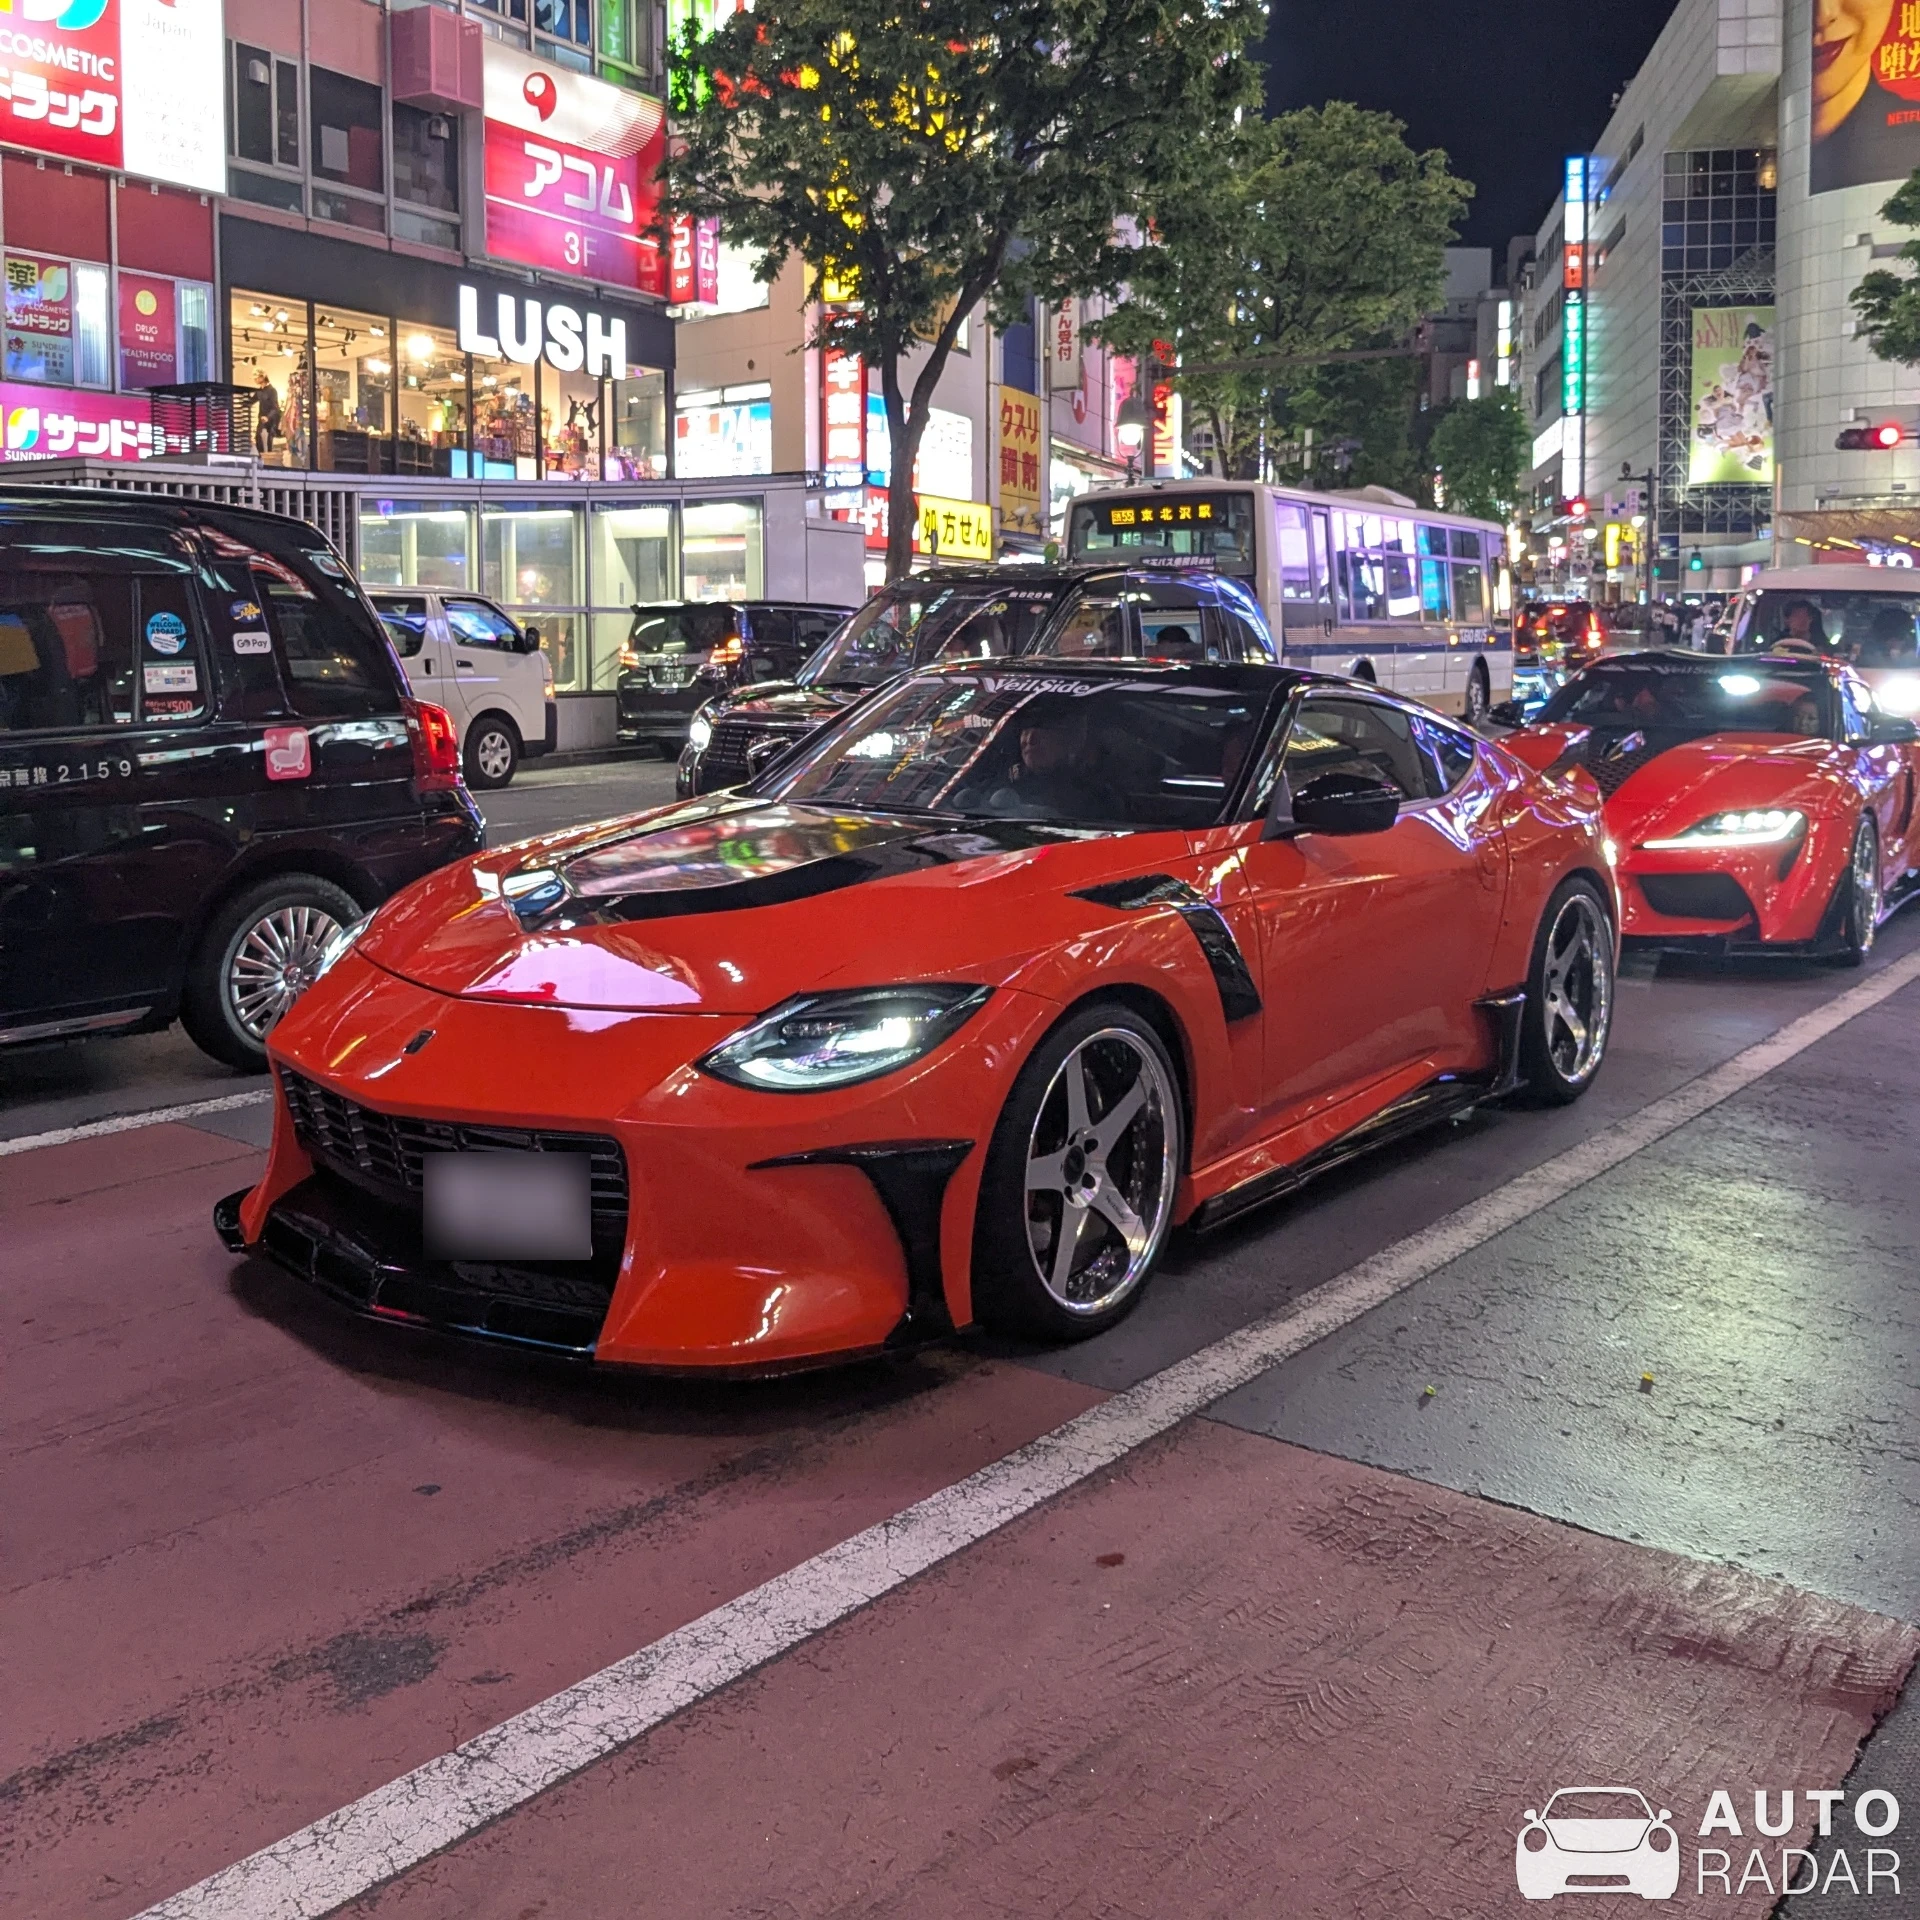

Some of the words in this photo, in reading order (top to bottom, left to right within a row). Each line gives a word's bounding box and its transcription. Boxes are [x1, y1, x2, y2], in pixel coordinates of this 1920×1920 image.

[523, 141, 634, 224] アコム
[563, 231, 597, 267] 3F
[8, 262, 36, 294] 薬
[675, 275, 690, 289] 3F
[135, 323, 158, 335] DRUG
[458, 284, 627, 381] LUSH
[150, 351, 174, 362] FOOD
[1001, 398, 1039, 445] クスリ
[1001, 446, 1038, 493] 調剤
[923, 508, 988, 548] 処方せん
[149, 621, 182, 629] WELCOME
[252, 638, 268, 649] Pay
[167, 700, 193, 713] ¥500
[57, 759, 132, 782] 2159
